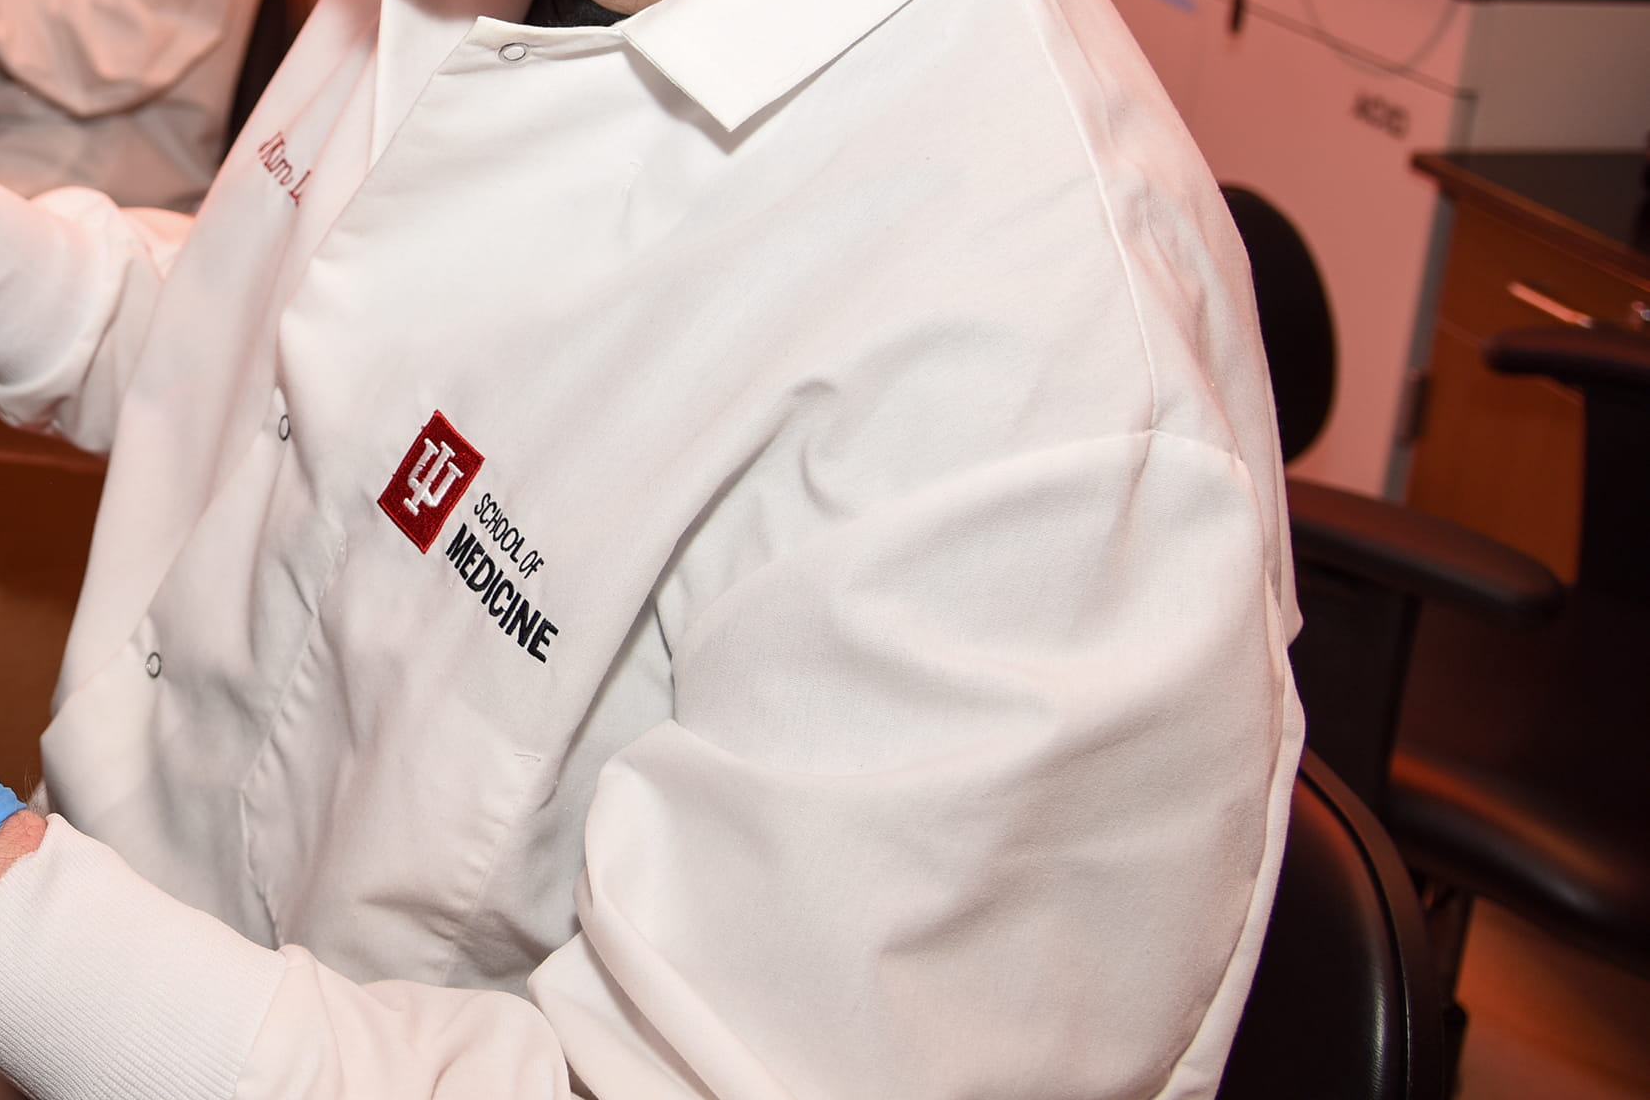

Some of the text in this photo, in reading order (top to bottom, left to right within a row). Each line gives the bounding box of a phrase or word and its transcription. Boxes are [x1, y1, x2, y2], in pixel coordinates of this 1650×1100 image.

[473, 492, 545, 579] SCHOOL OF
[445, 522, 559, 664] MEDICINE
